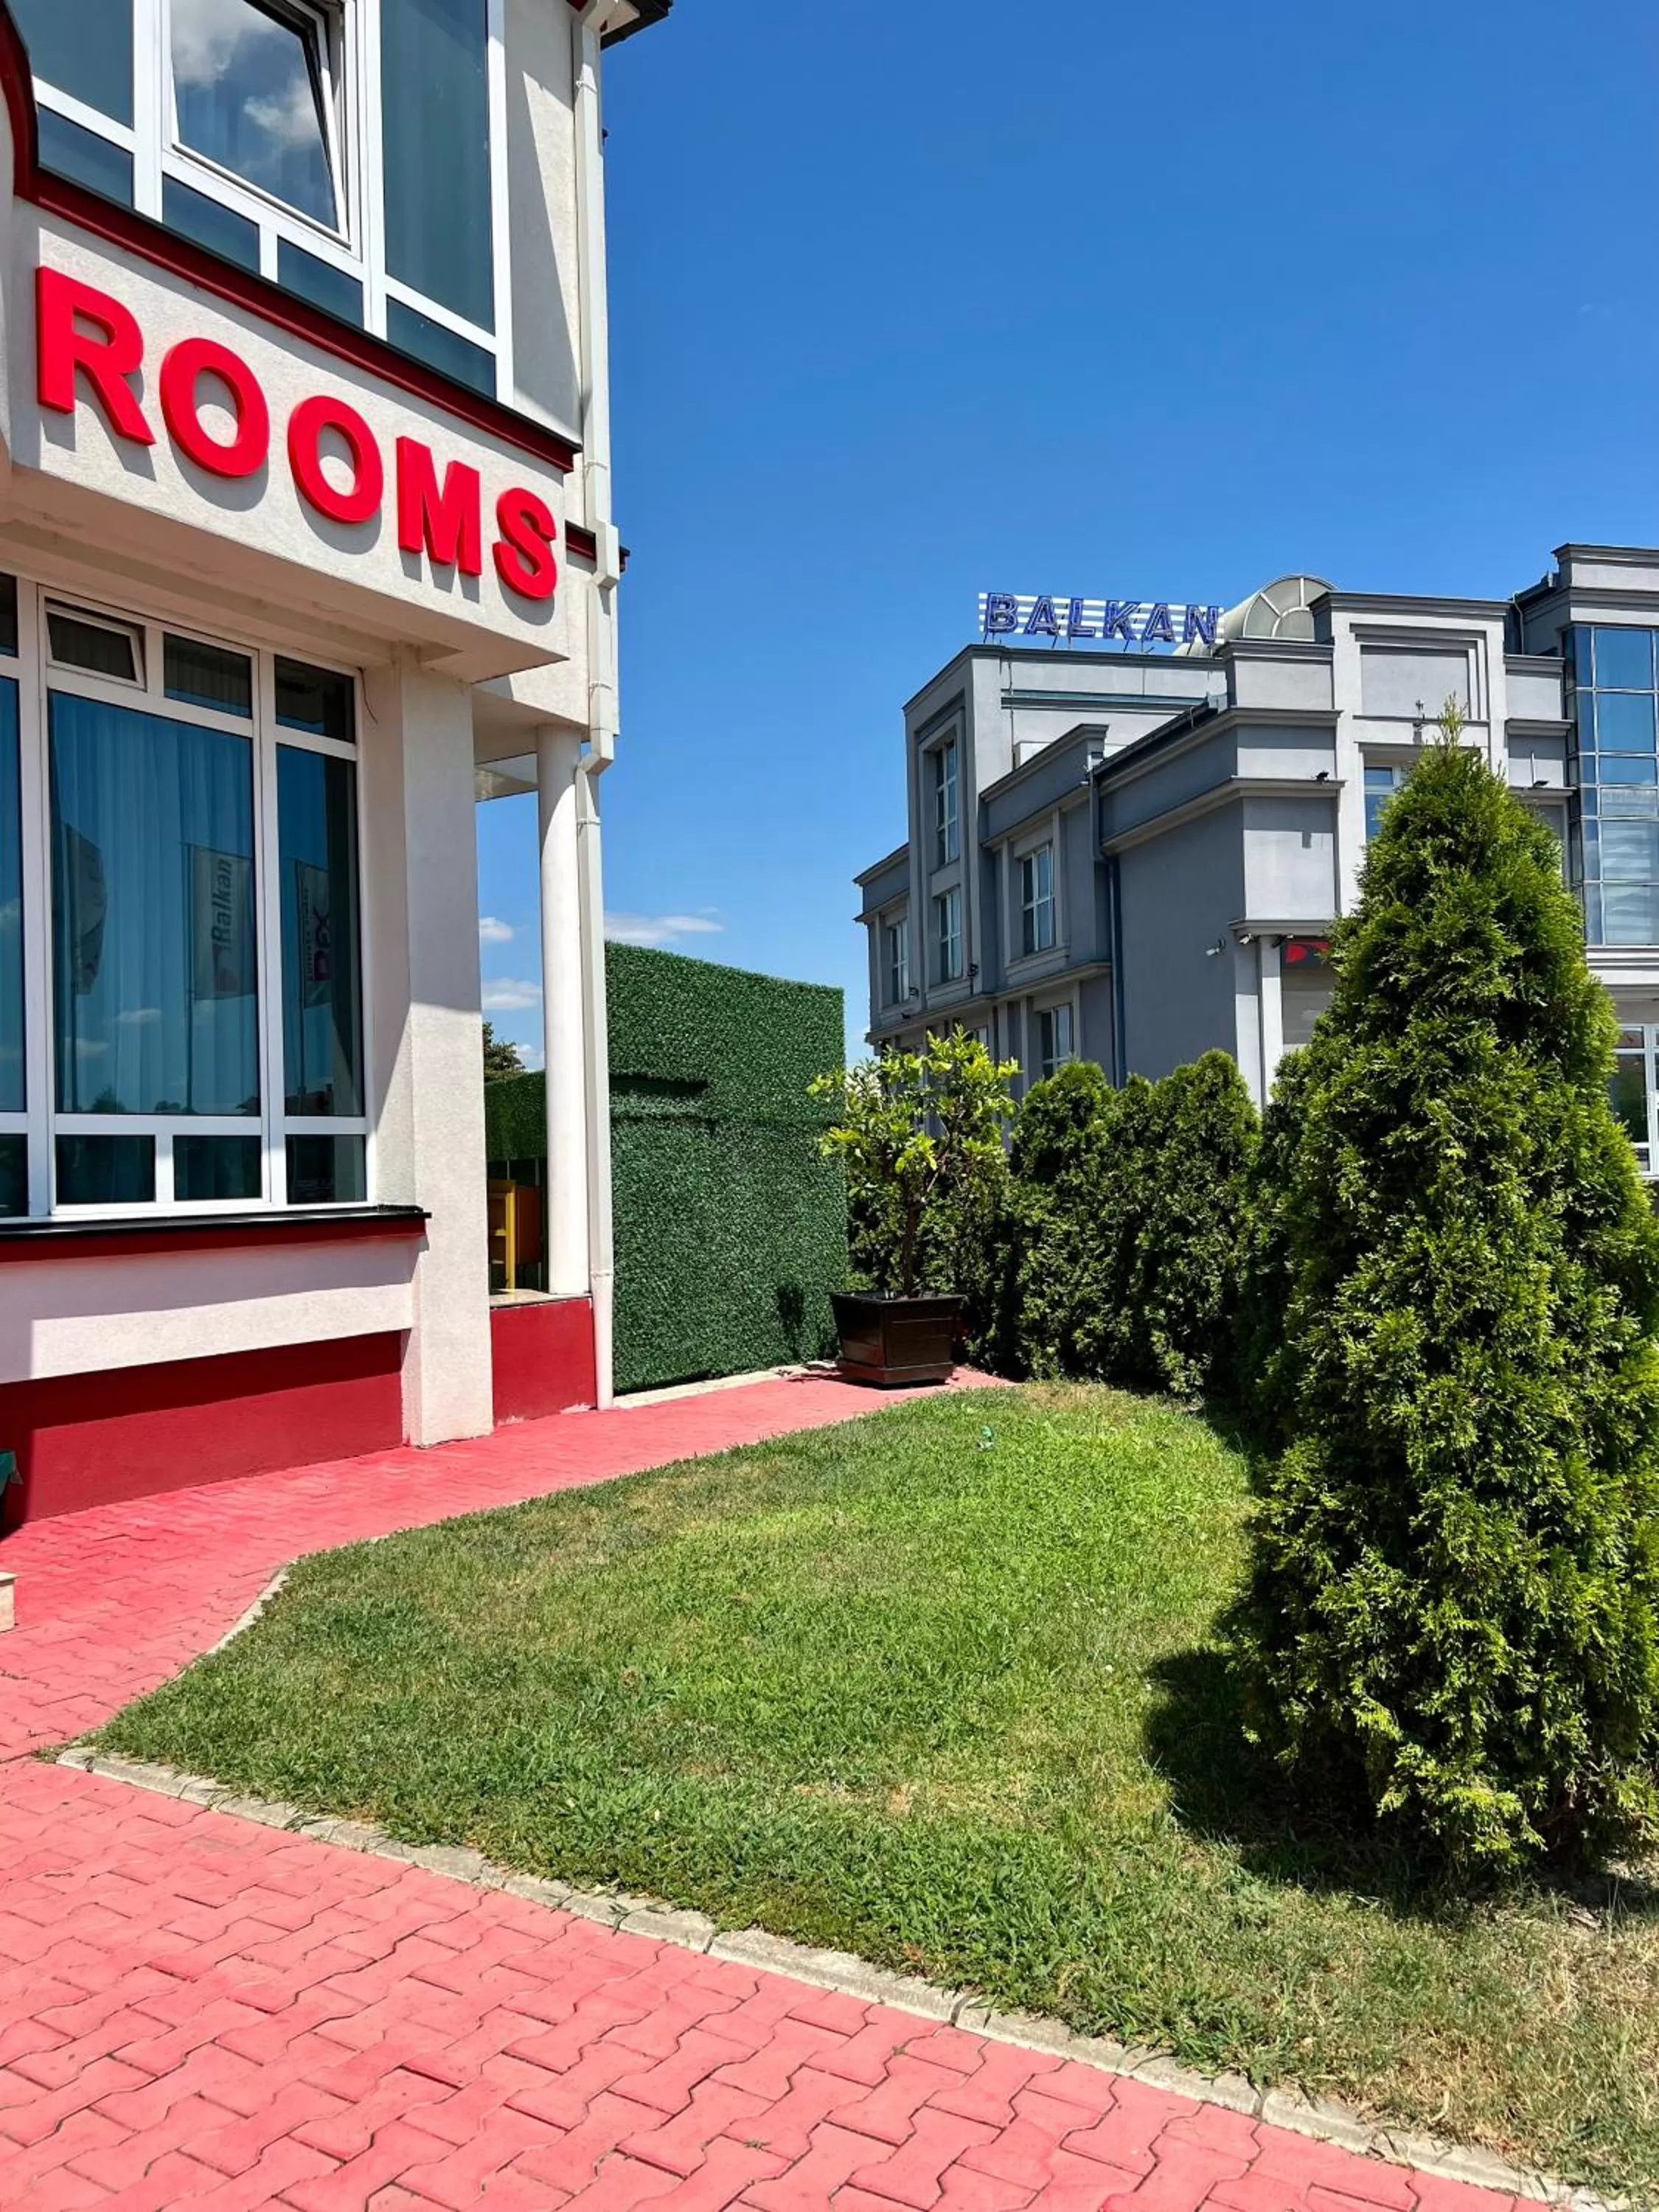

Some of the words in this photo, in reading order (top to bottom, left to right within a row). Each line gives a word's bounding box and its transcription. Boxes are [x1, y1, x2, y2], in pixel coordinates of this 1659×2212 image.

[35, 265, 558, 600] ROOMS
[984, 592, 1220, 644] BALKAN
[211, 858, 232, 944] Balkan
